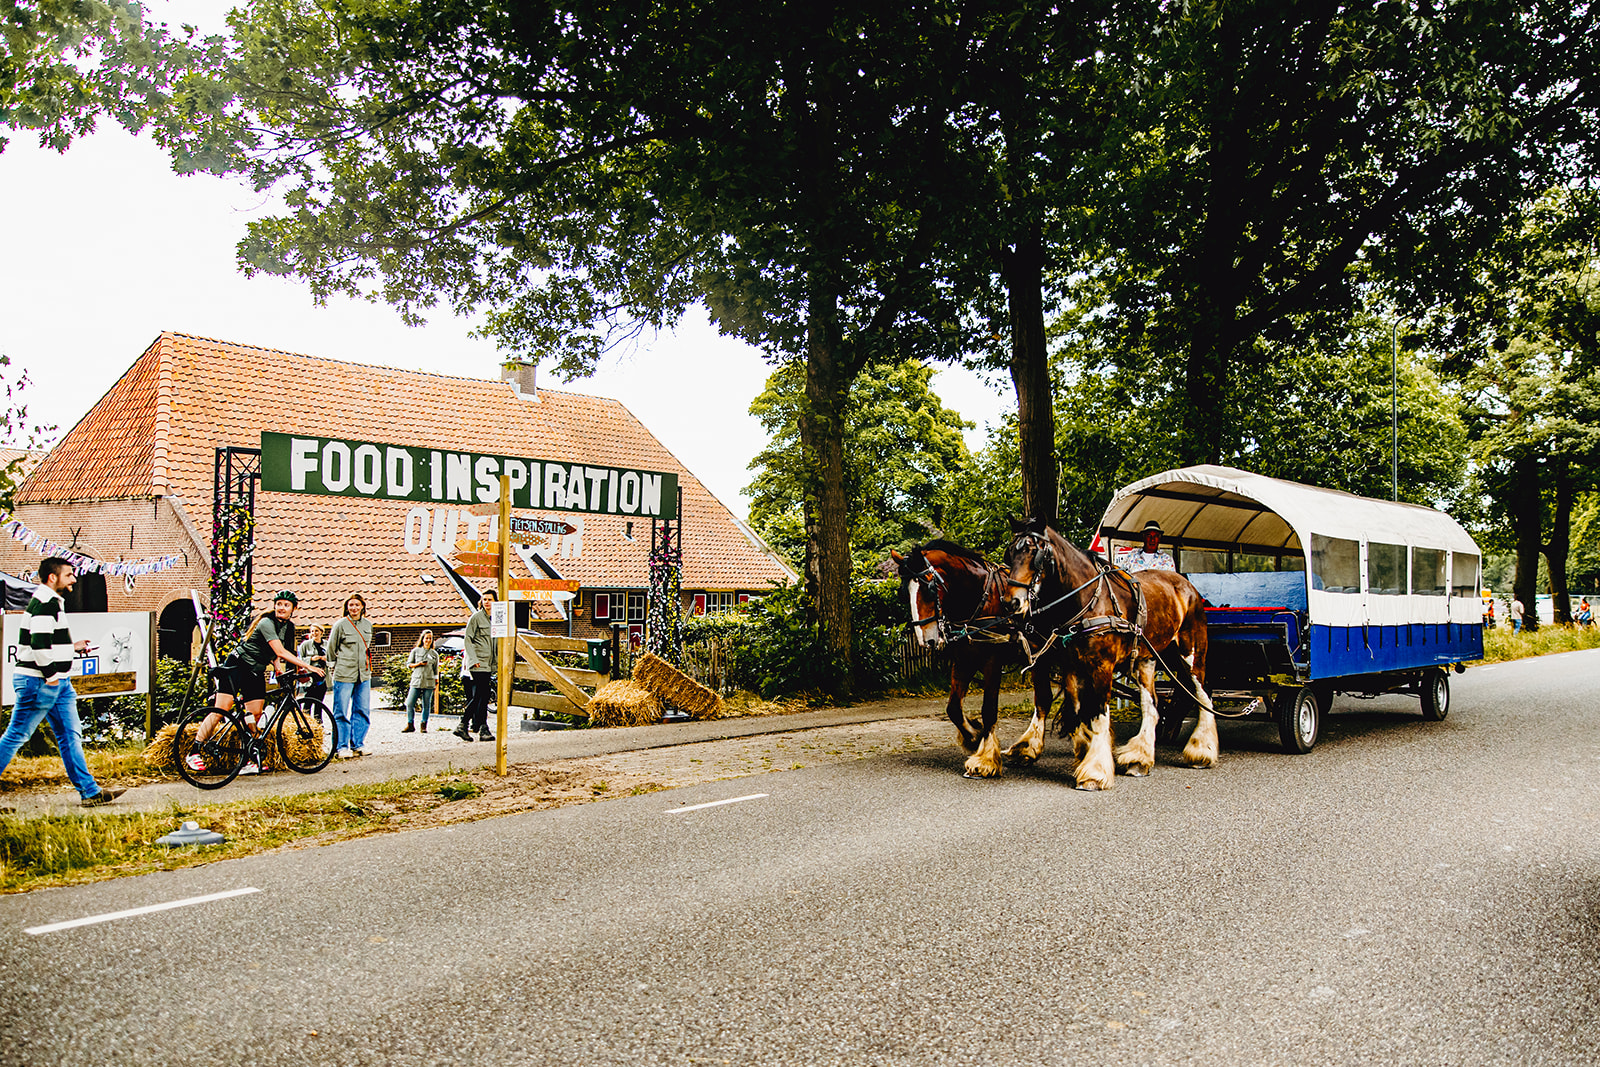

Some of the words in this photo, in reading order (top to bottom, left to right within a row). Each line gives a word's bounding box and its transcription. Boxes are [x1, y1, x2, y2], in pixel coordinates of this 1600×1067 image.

[291, 437, 414, 497] FOOD
[429, 451, 662, 516] INSPIRATION
[404, 506, 585, 558] OUTOR
[475, 540, 489, 552] P2
[477, 553, 492, 565] P3
[479, 565, 492, 577] P4
[522, 590, 553, 600] STATION
[85, 661, 94, 674] P
